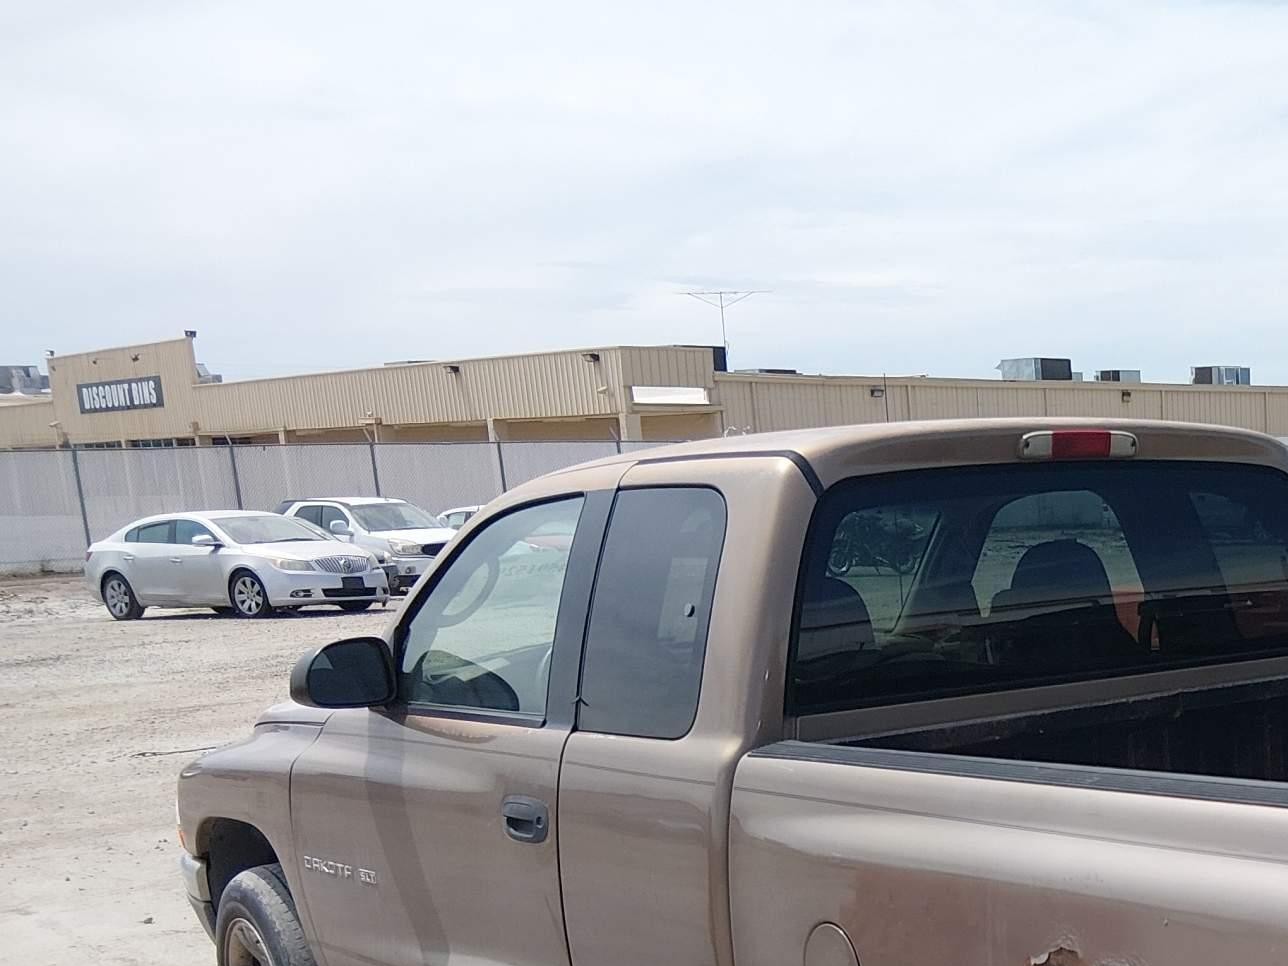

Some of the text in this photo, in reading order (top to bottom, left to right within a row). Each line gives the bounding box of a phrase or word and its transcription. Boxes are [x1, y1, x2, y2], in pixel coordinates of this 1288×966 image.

[82, 380, 157, 409] DISCOUNT BINS
[303, 855, 352, 878] DAKOTA
